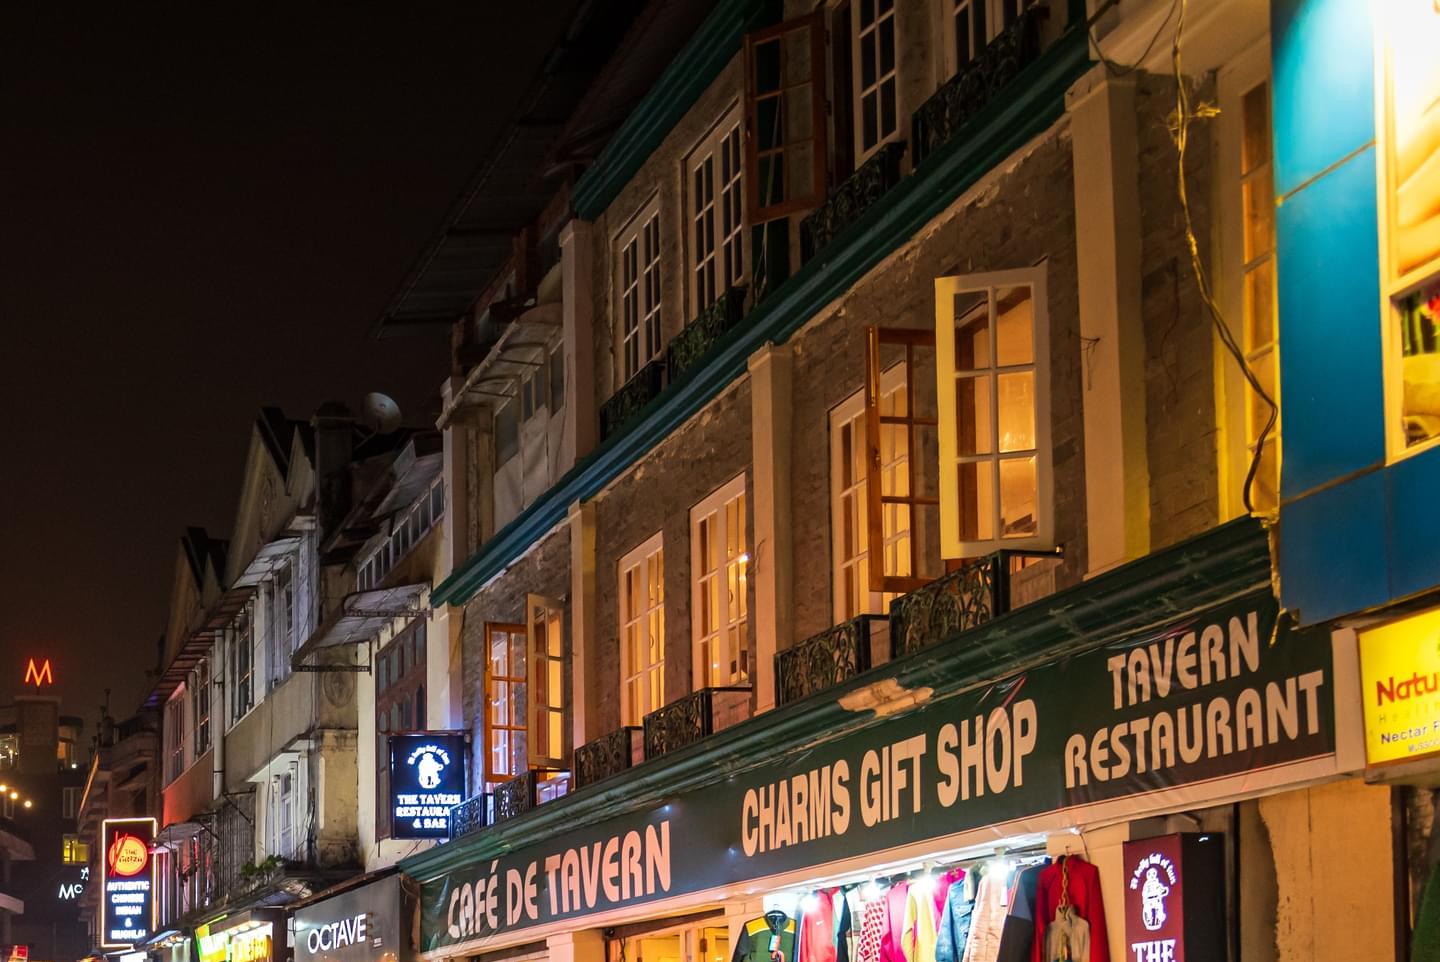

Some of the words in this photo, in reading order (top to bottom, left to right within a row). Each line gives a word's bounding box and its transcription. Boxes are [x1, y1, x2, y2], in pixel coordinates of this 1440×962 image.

[25, 658, 53, 686] M
[1107, 611, 1259, 710] TAVERN
[1065, 670, 1323, 789] RESTAURANT
[1381, 724, 1427, 744] Nectar
[741, 759, 850, 857] CHARMS
[860, 733, 926, 827] GIFT
[937, 698, 1038, 807] SHOP
[396, 794, 418, 804] THE
[419, 793, 461, 805] TAVERN
[413, 818, 422, 828] &
[424, 818, 447, 828] BAR
[448, 859, 499, 939] CAFÉ
[506, 861, 538, 926] DE
[545, 820, 671, 915] TAVERN
[307, 913, 366, 954] OCTAVE
